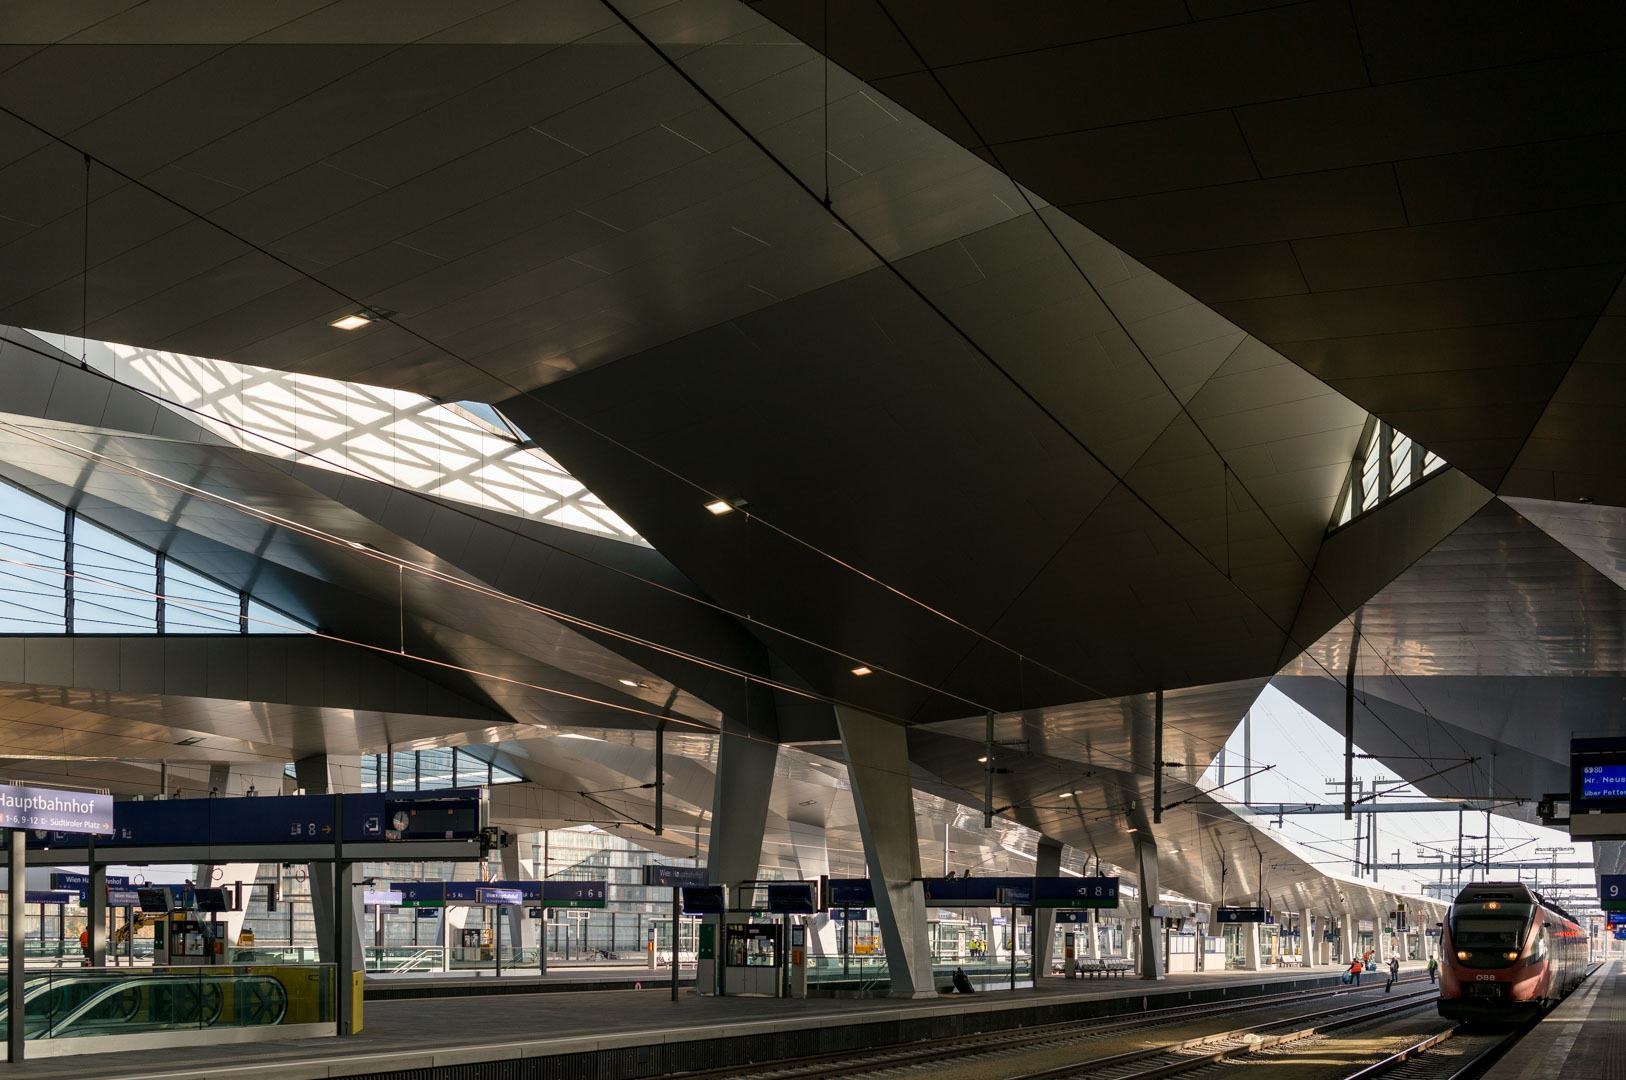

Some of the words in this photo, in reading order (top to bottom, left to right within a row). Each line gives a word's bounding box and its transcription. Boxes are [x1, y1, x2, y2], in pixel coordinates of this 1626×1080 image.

[21, 816, 40, 825] 9-12
[50, 818, 82, 828] Südtiroler
[84, 820, 100, 829] Platz
[308, 823, 316, 836] 8
[81, 891, 86, 899] 3
[588, 889, 593, 897] 6
[1094, 886, 1102, 897] 8
[1609, 885, 1619, 897] 9
